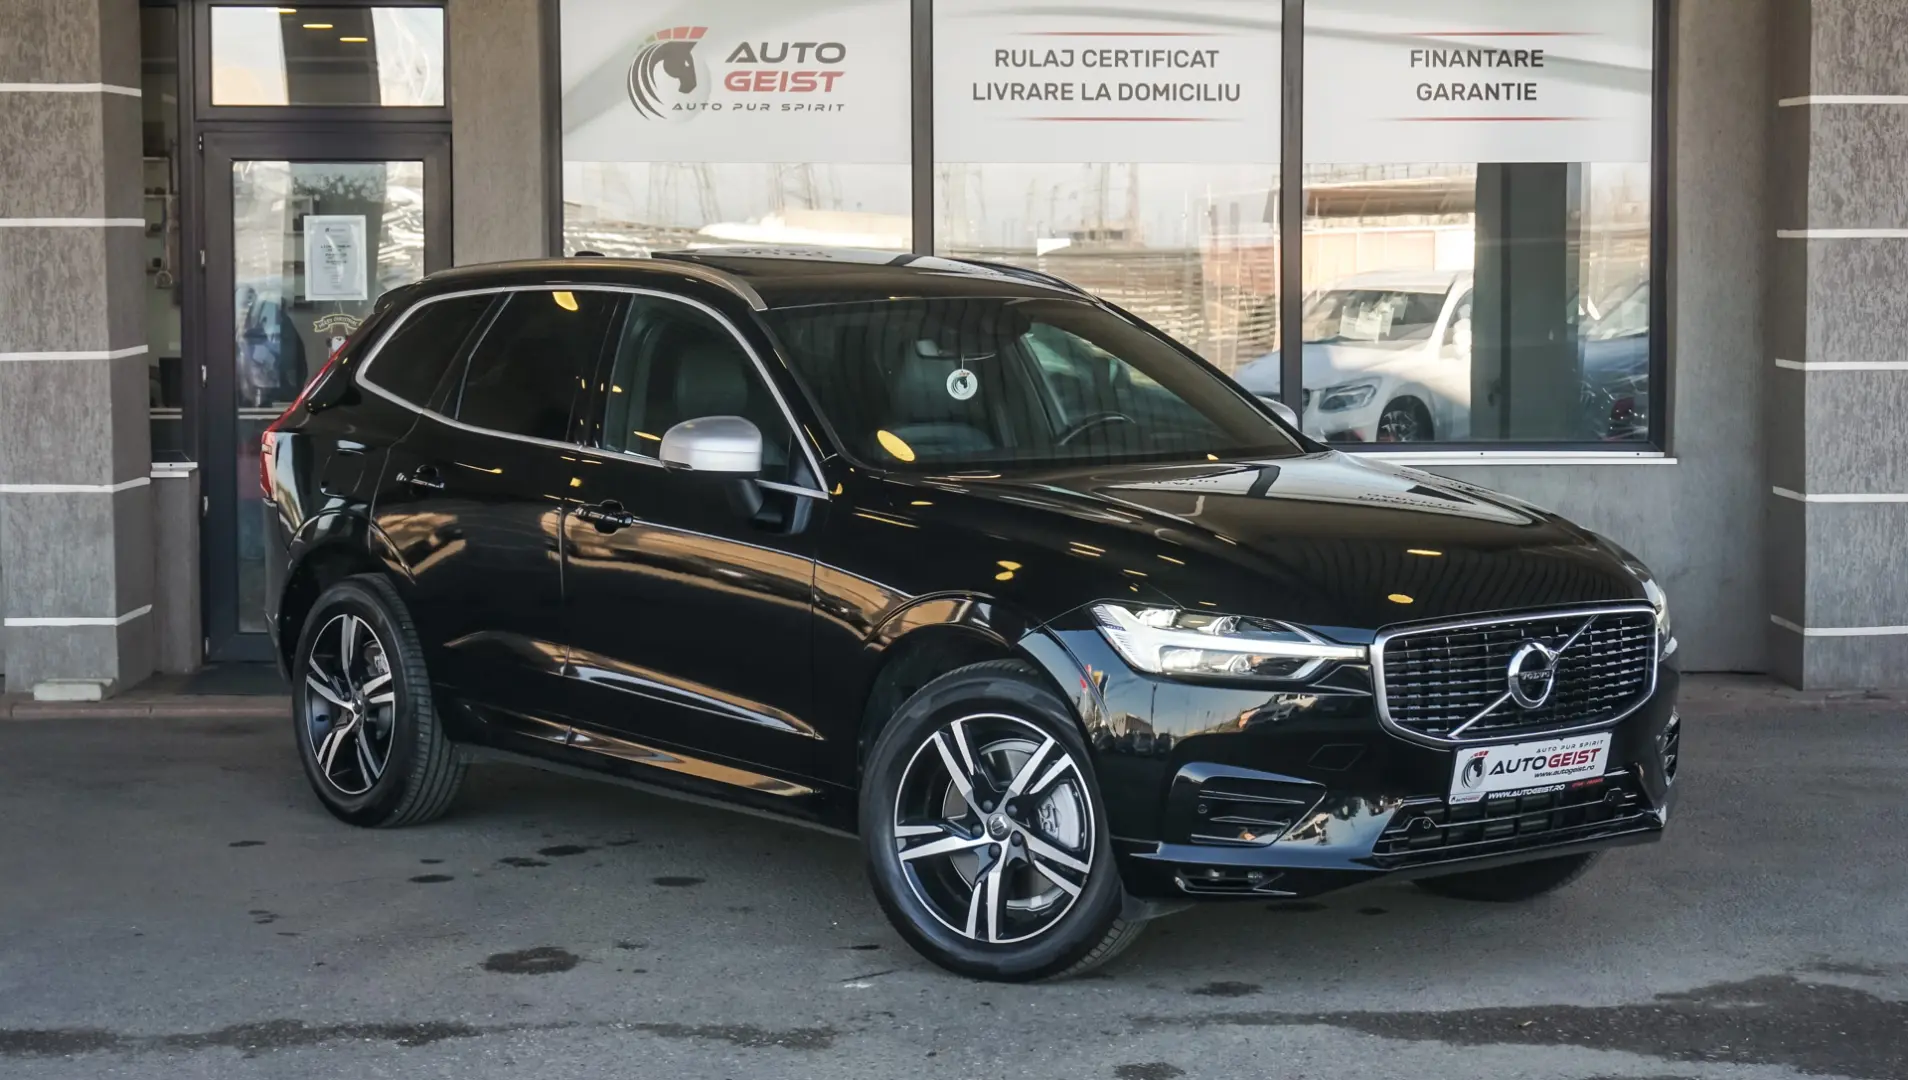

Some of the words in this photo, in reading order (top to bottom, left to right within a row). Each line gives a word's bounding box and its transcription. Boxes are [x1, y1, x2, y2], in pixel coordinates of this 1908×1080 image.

[725, 42, 846, 64] AUTO
[995, 49, 1074, 67] RULAJ
[1082, 50, 1219, 68] CERTIFICAT
[1410, 50, 1544, 67] FINANTARE
[724, 71, 845, 92] GEIST
[973, 83, 1074, 100] LIVRARE
[1081, 83, 1112, 100] LA
[1118, 83, 1241, 101] DOMICILIU
[1416, 83, 1537, 101] GARANTIE
[672, 103, 722, 111] AUTO
[732, 103, 770, 111] PUR
[781, 103, 844, 111] SPIRIT
[1580, 740, 1603, 748] SPIRIT
[1534, 765, 1595, 778] www.autogeist.ro
[1488, 784, 1566, 799] WWW.AUTOGEIST.RO
